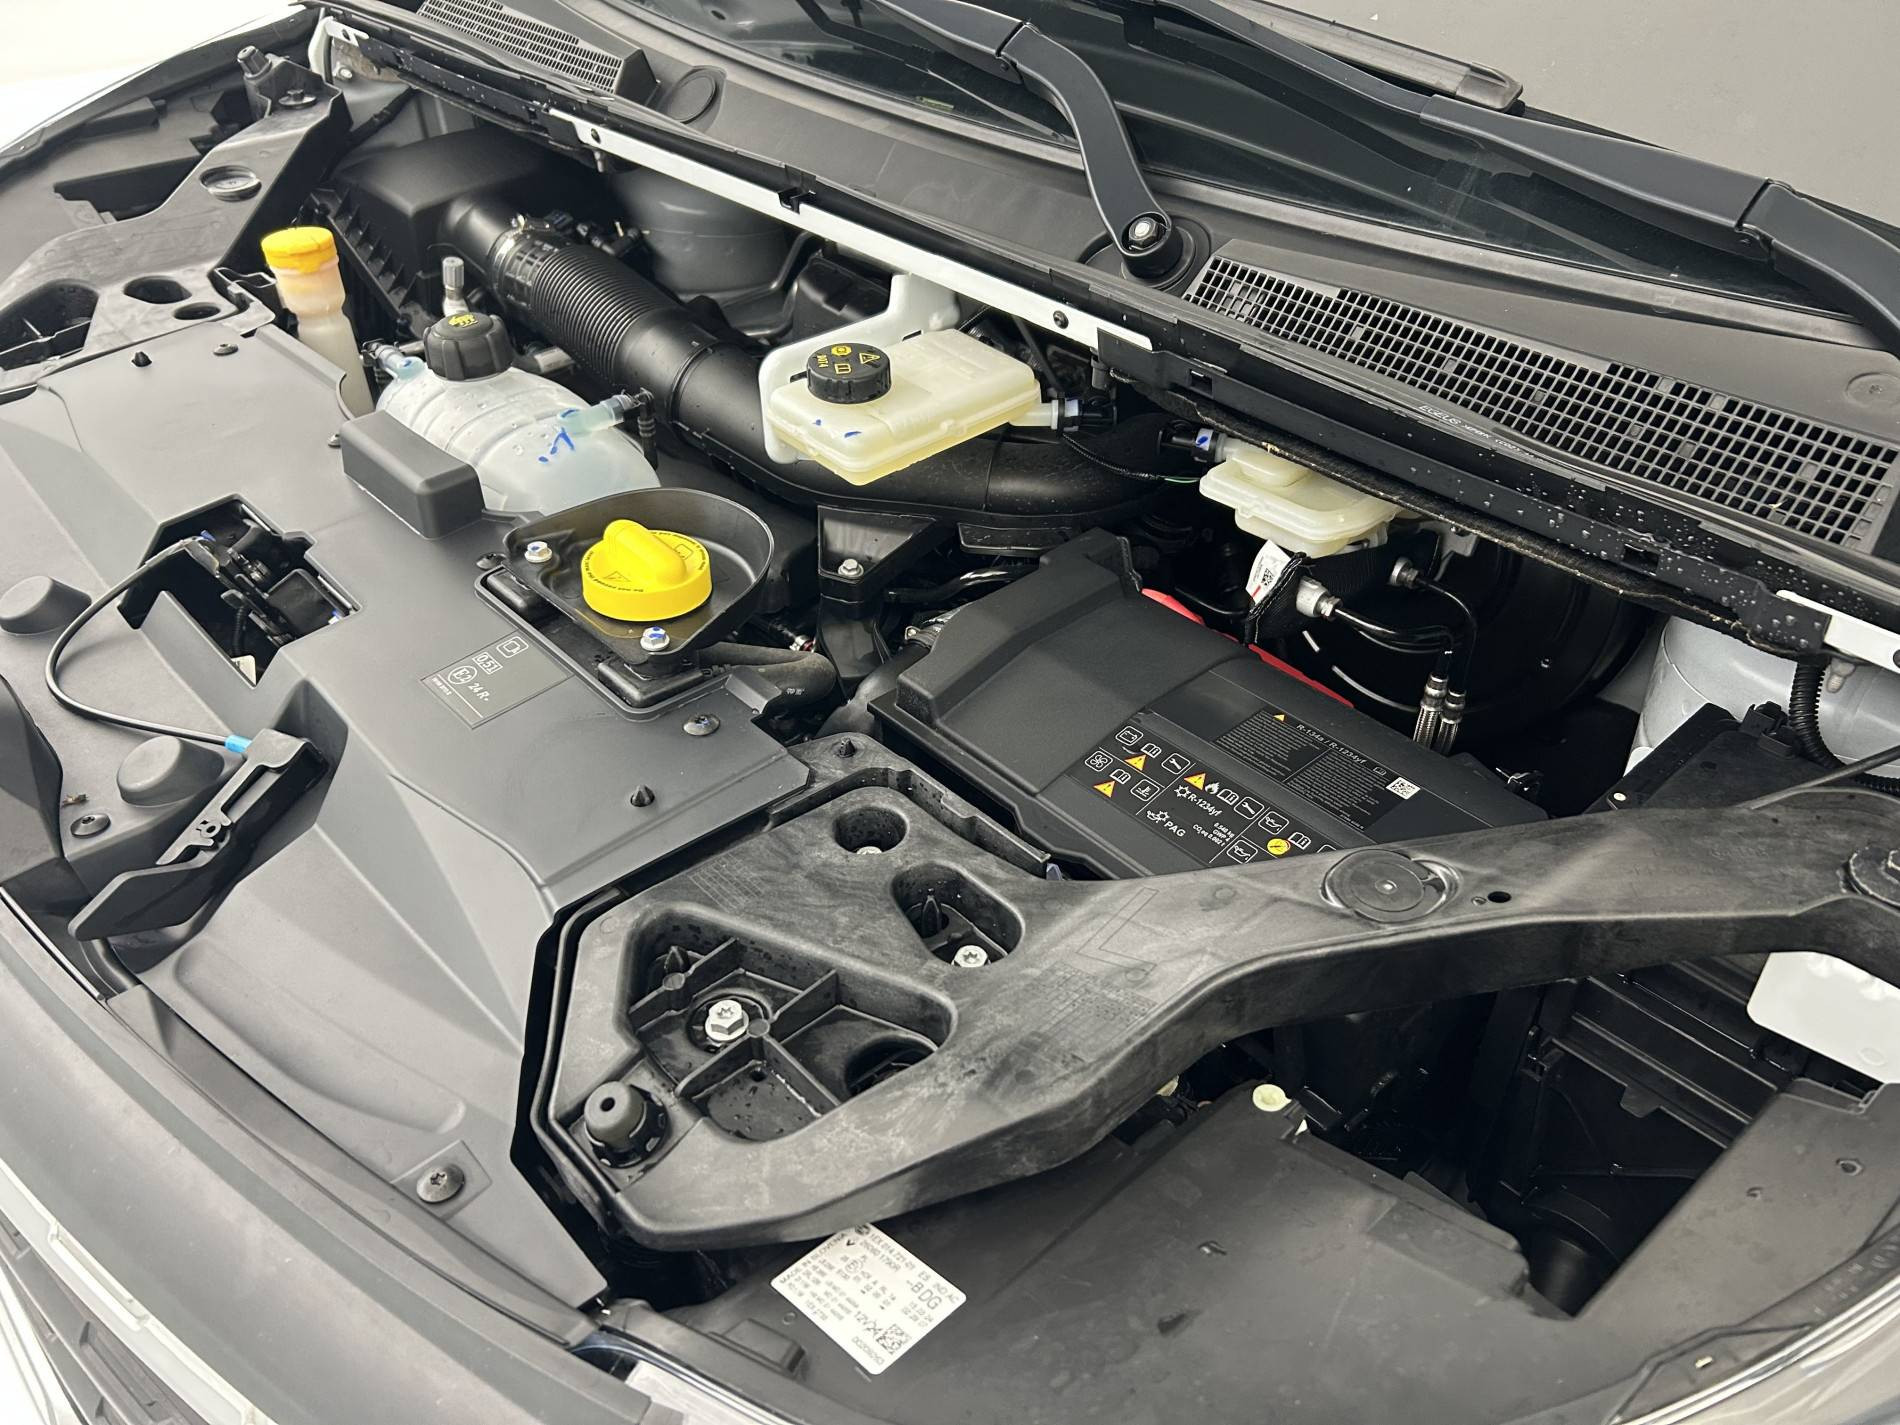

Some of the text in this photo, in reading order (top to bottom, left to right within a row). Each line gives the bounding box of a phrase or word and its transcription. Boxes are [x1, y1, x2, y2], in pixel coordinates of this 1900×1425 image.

[1296, 724, 1324, 741] R-134a
[1328, 742, 1367, 764] R-1234yf
[1187, 793, 1223, 817] R-1234yf
[1163, 820, 1186, 838] PAG
[1212, 829, 1227, 839] GWP
